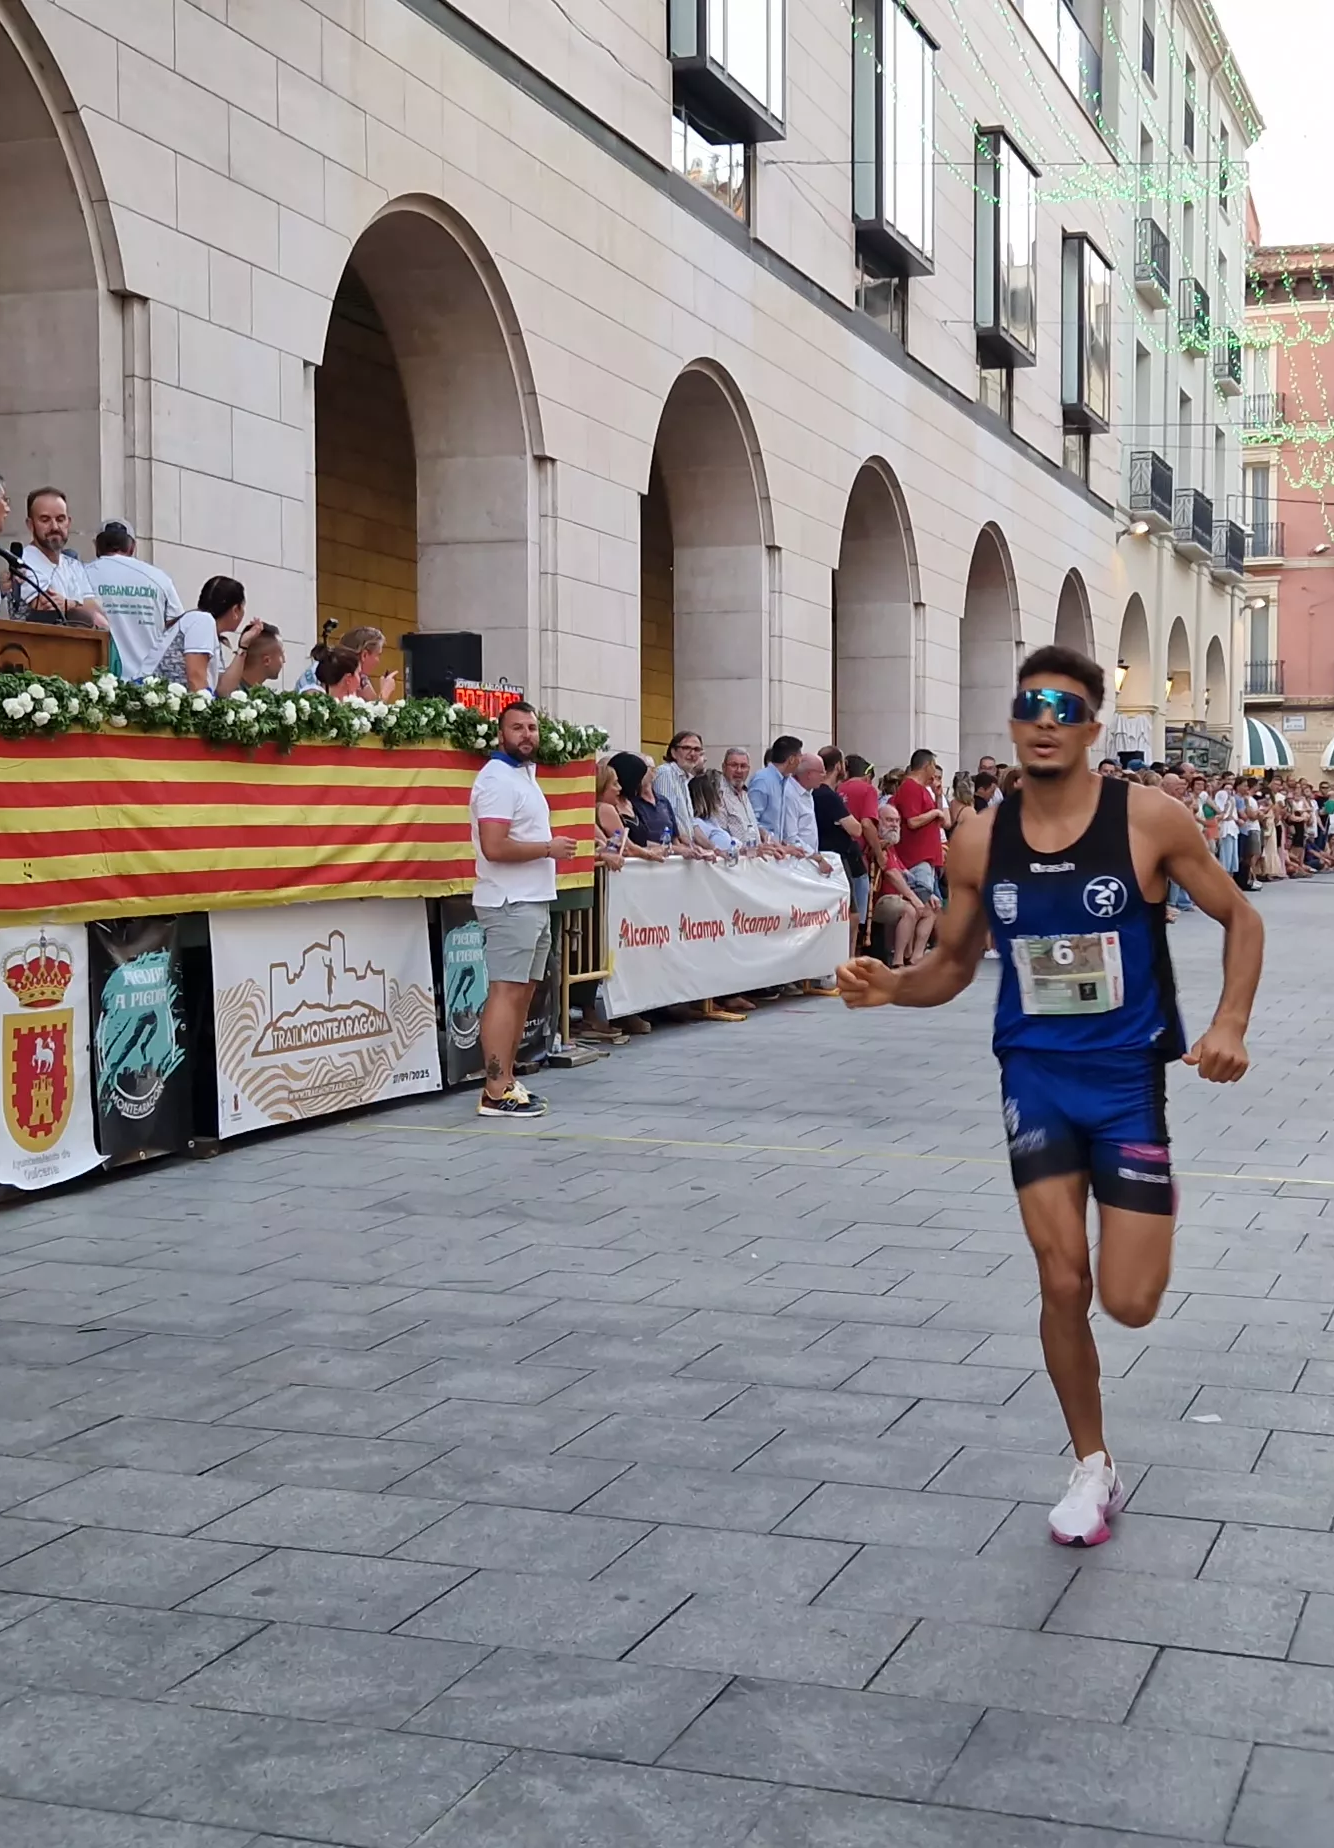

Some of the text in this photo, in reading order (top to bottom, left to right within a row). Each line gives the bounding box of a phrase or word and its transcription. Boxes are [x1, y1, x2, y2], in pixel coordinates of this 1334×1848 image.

[98, 584, 158, 599] ORGANIZACIÓN
[619, 918, 670, 948] Alcampo
[679, 913, 725, 942] Alcampo
[732, 908, 780, 936] Alcampo
[788, 905, 830, 929] Alcampo
[1052, 940, 1075, 965] 6
[116, 994, 126, 1009] A
